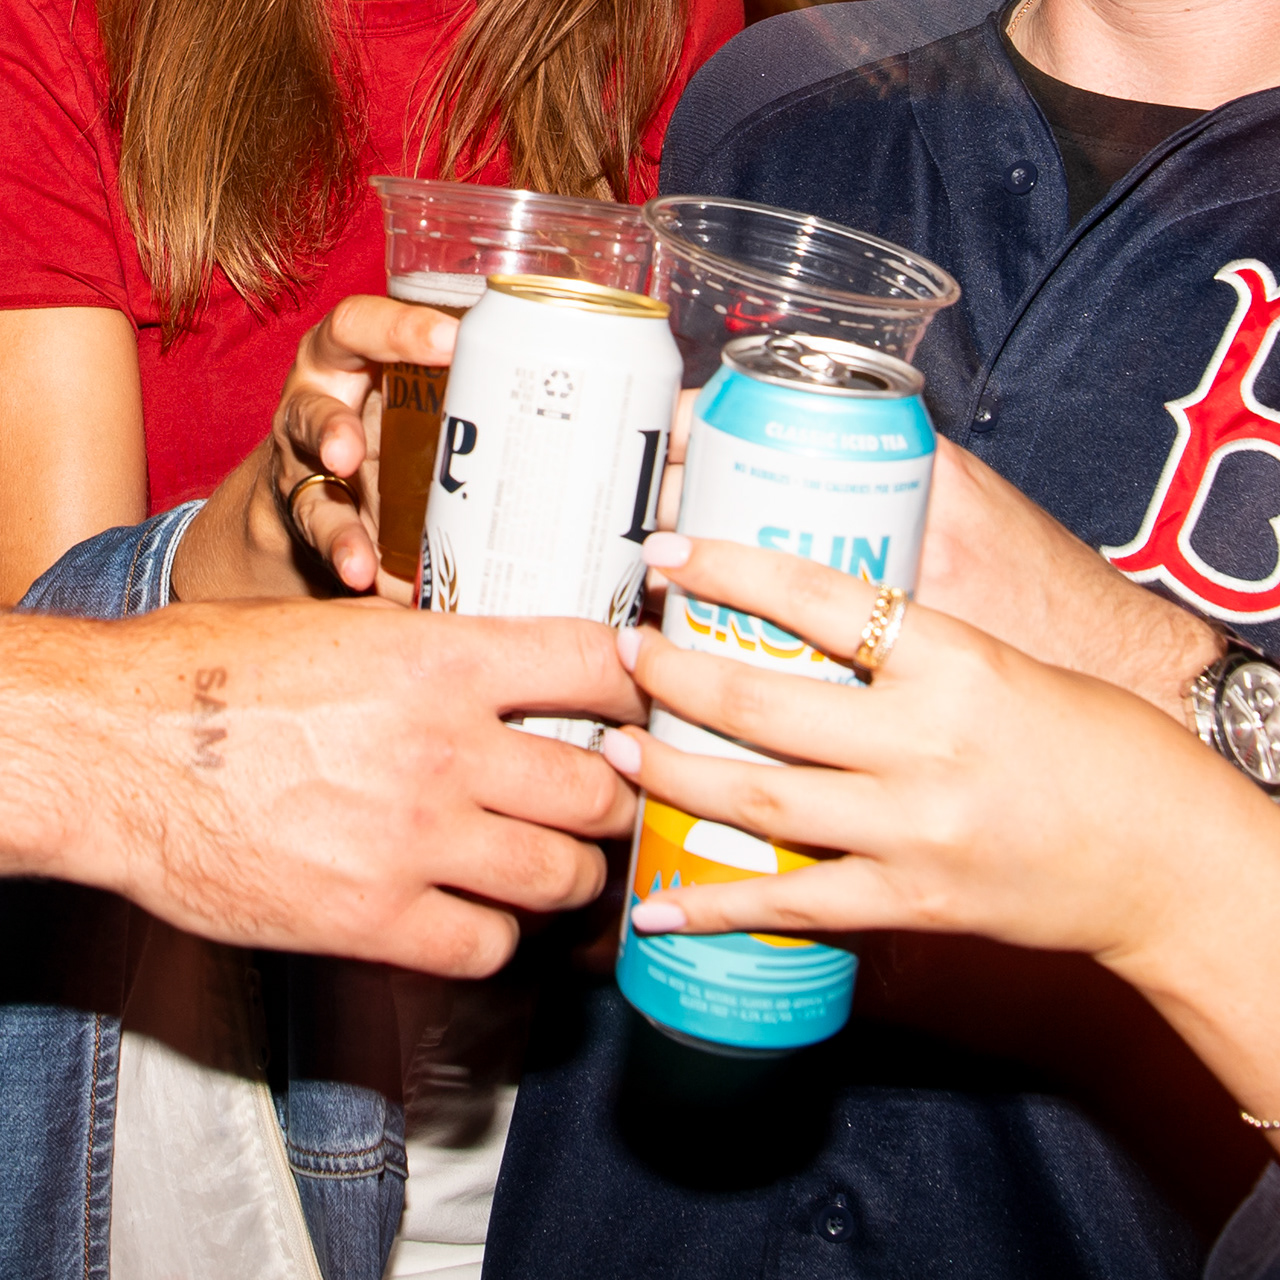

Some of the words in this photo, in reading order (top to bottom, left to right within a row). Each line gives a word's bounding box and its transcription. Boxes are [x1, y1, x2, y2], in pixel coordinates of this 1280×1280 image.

[765, 421, 837, 449] CLASSIC
[840, 433, 879, 452] ICED
[880, 433, 908, 452] TEA
